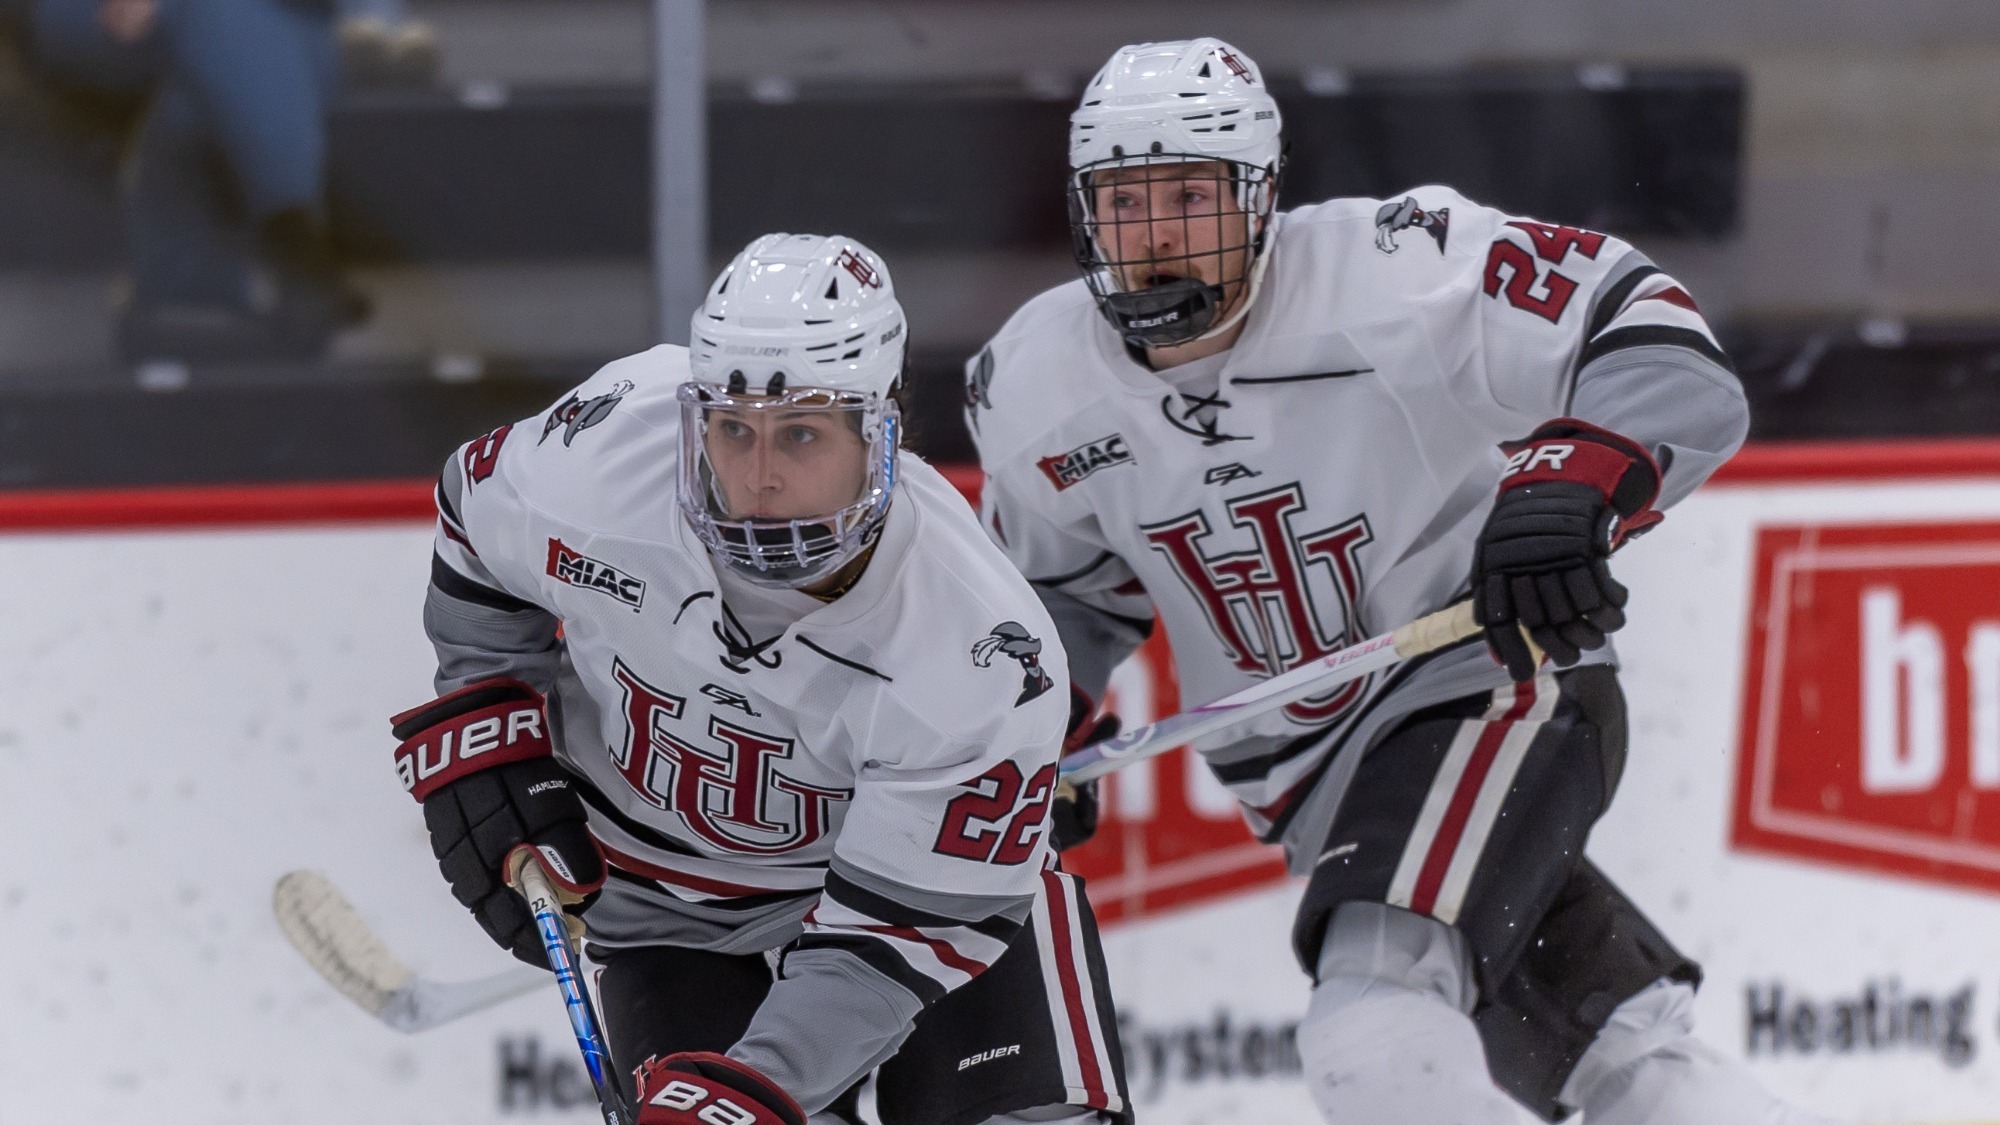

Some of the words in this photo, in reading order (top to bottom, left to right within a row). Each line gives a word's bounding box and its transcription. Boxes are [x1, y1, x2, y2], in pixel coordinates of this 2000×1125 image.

[1483, 221, 1608, 326] 24
[1053, 436, 1131, 484] MIAC
[557, 551, 644, 604] MIAC
[394, 708, 543, 793] AUER
[931, 758, 1057, 867] 22
[531, 896, 548, 914] 22
[957, 1044, 1021, 1072] BAUER
[1744, 978, 1978, 1070] Heating
